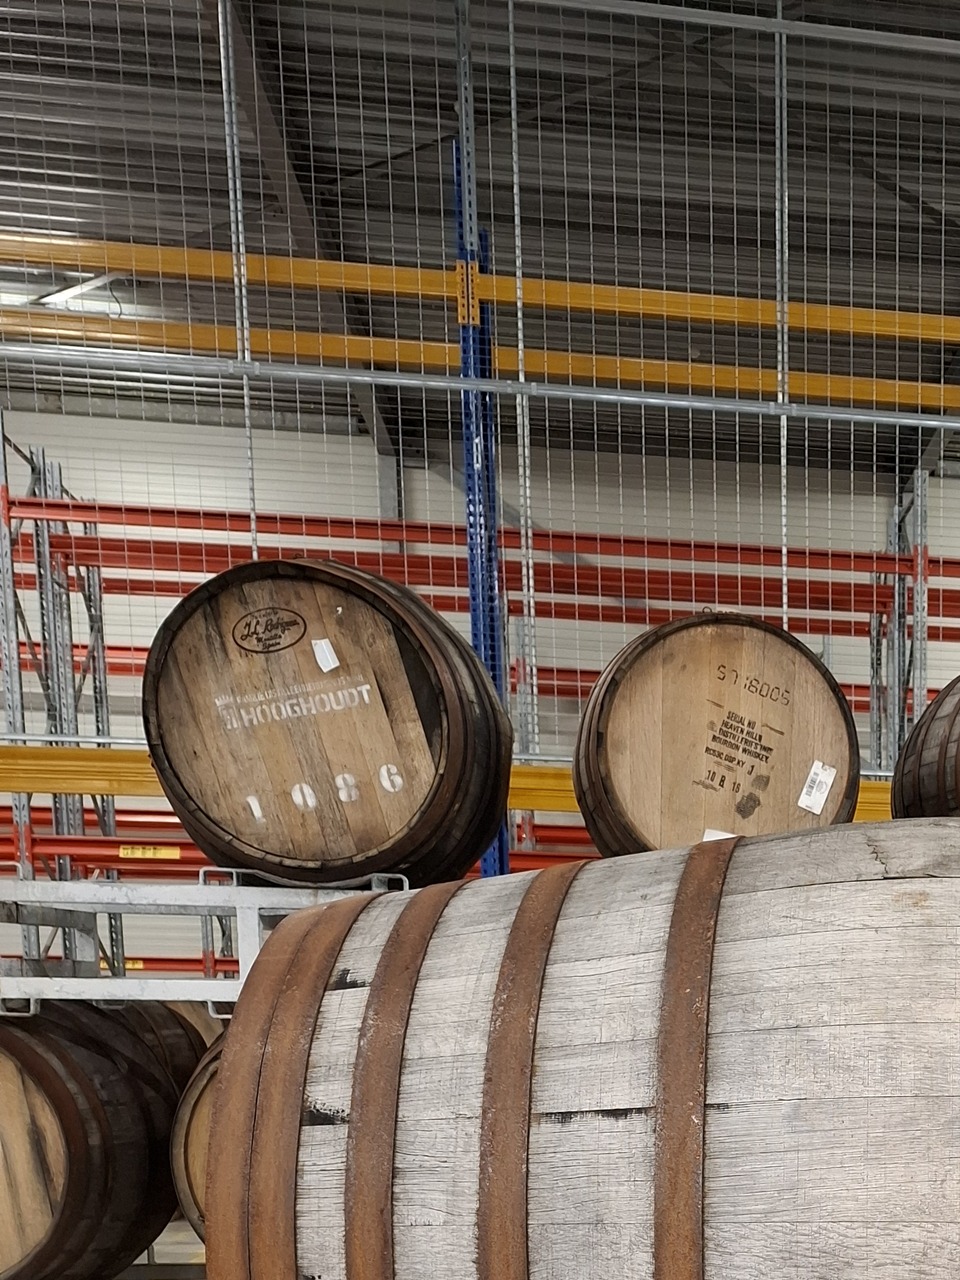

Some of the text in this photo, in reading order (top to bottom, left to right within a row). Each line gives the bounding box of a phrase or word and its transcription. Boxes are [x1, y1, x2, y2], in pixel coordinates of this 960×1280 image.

[239, 684, 371, 727] HOOGHOUDT
[721, 719, 745, 735] HEAVEN
[711, 734, 770, 764] BOURBON WHISKEY
[246, 763, 404, 824] 1086
